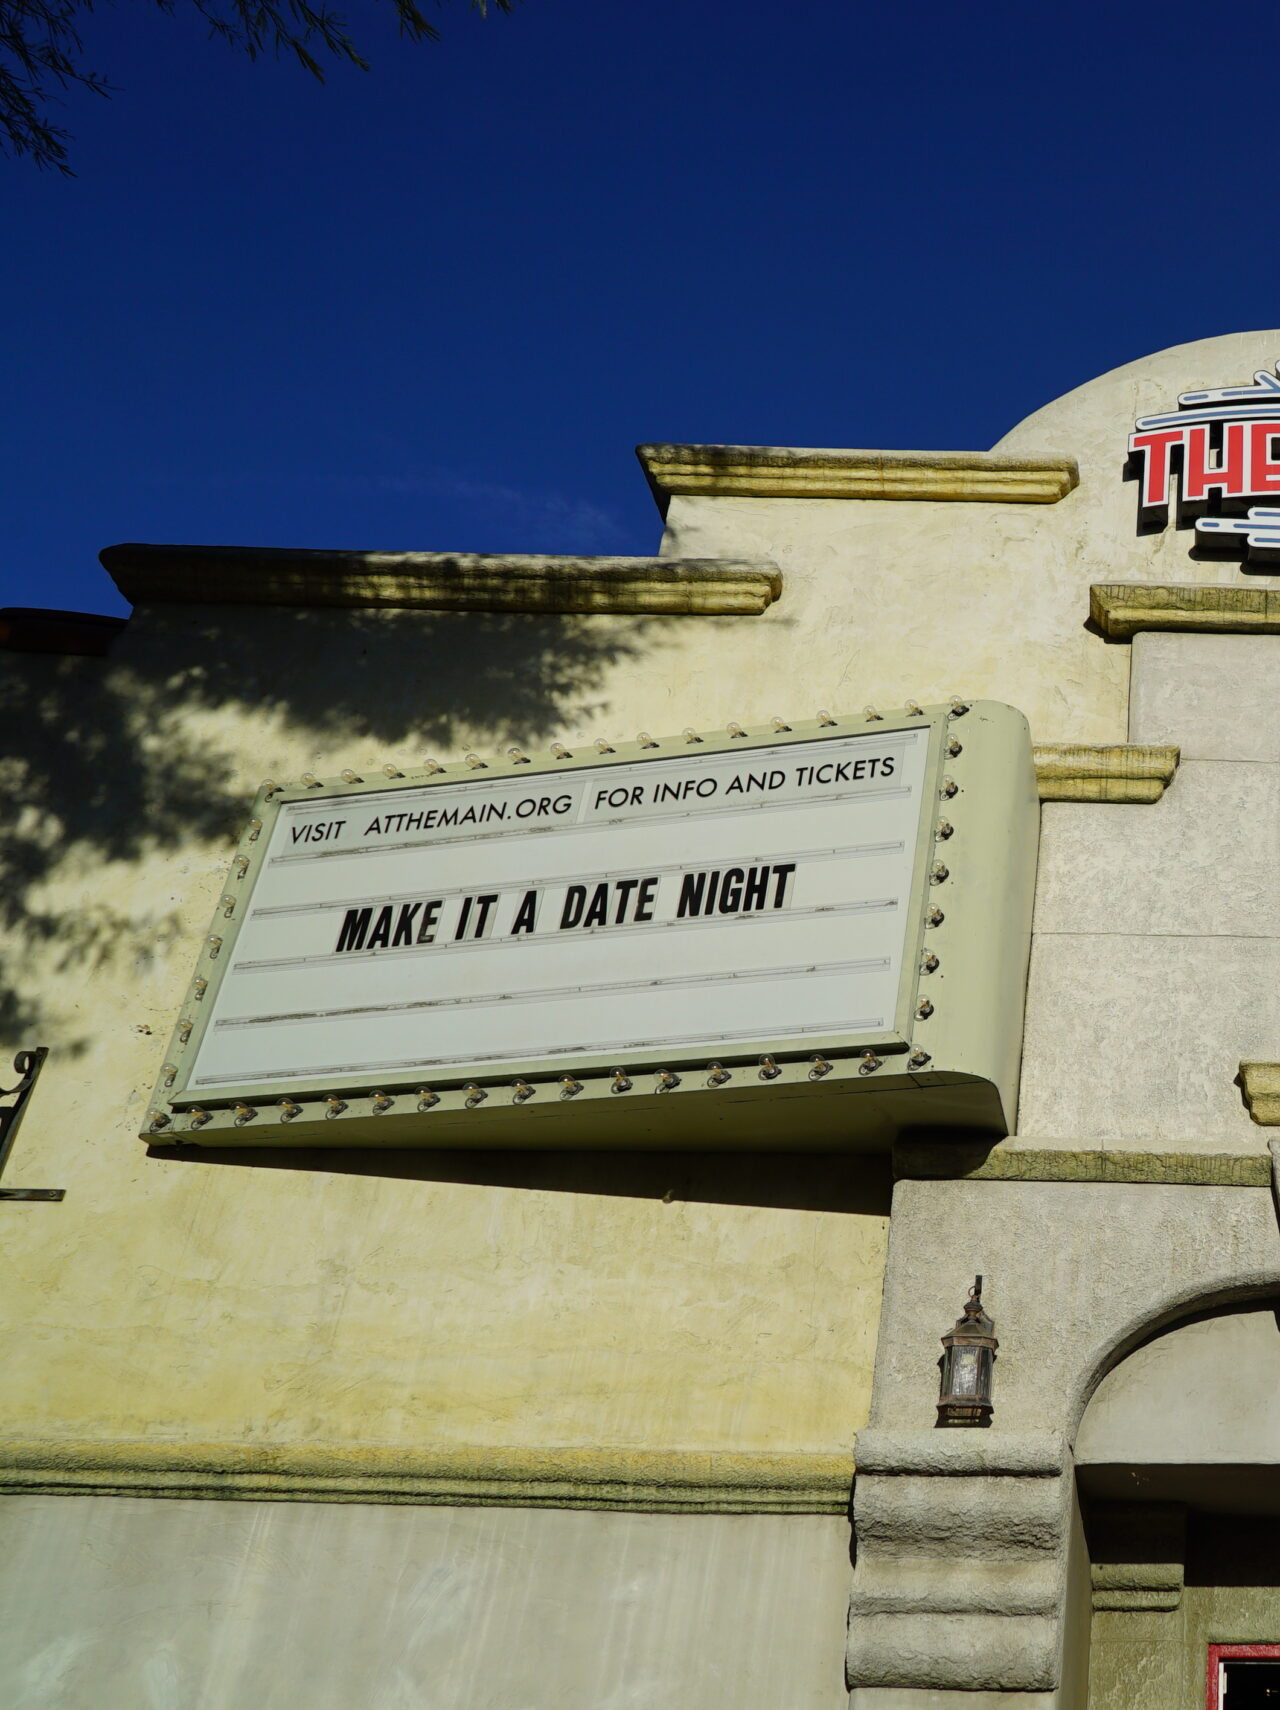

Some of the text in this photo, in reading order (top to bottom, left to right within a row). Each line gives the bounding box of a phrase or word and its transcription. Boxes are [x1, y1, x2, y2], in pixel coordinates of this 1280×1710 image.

[290, 756, 896, 845] VISIT ATTHEMAIN.ORG FOR INFO AND TICKETS
[335, 863, 797, 953] MAKE IT A DATE NIGHT
